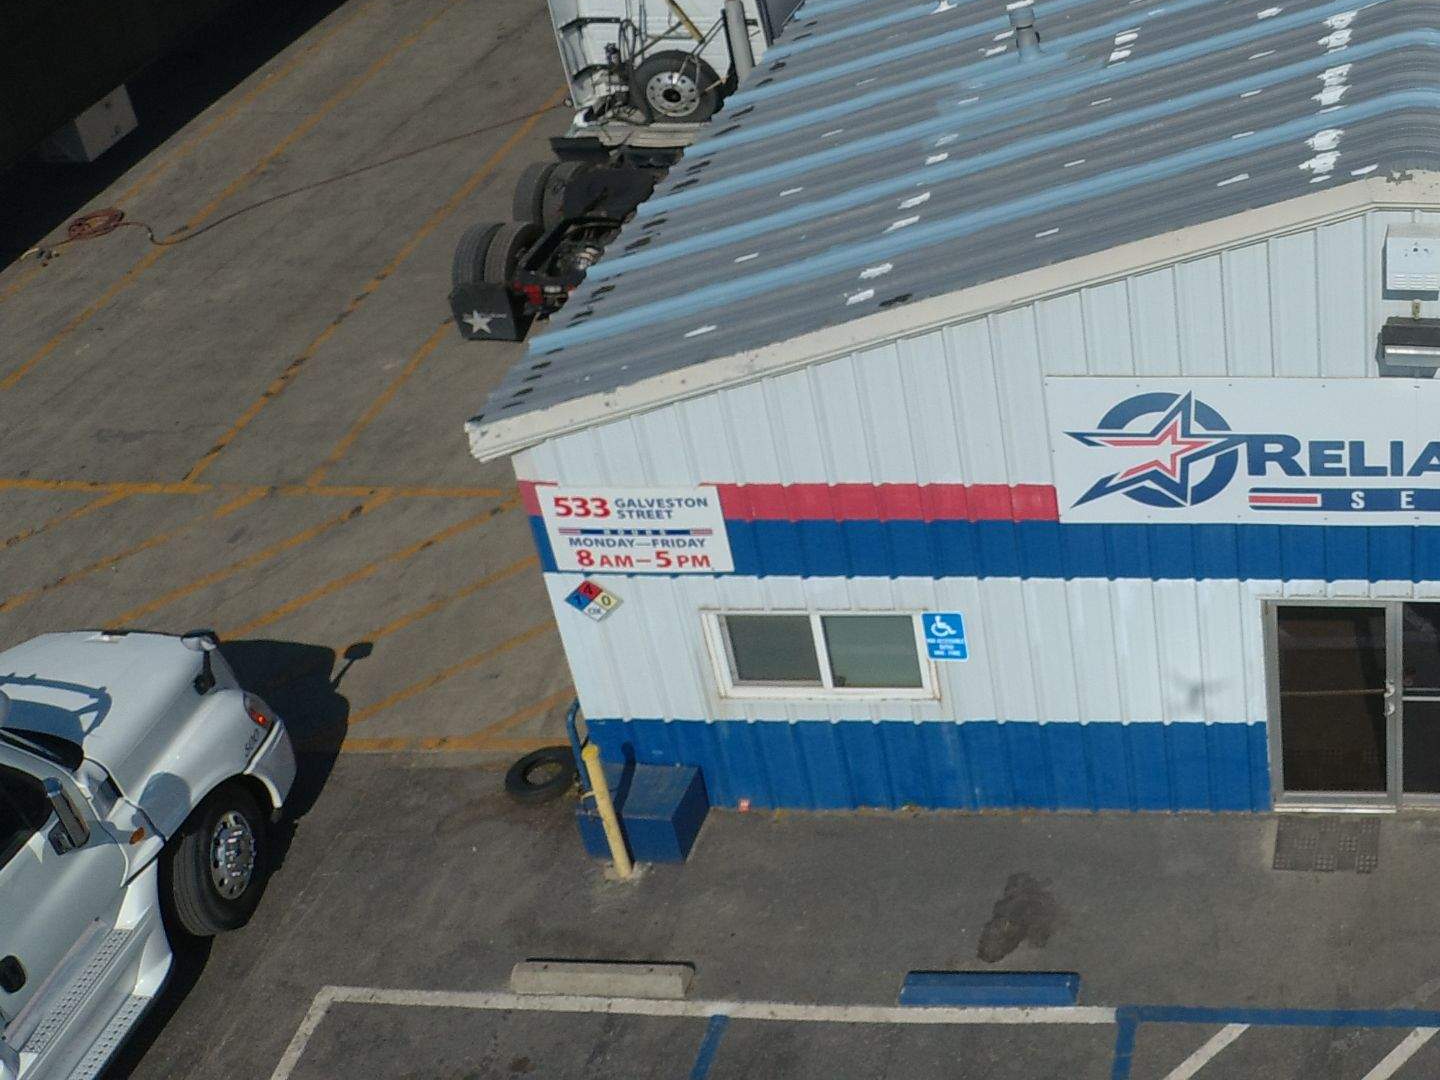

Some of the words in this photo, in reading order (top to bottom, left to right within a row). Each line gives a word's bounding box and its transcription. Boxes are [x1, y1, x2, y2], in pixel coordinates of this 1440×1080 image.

[552, 495, 612, 519] 533
[614, 496, 709, 509] GALVESTON
[616, 509, 674, 520] STREET
